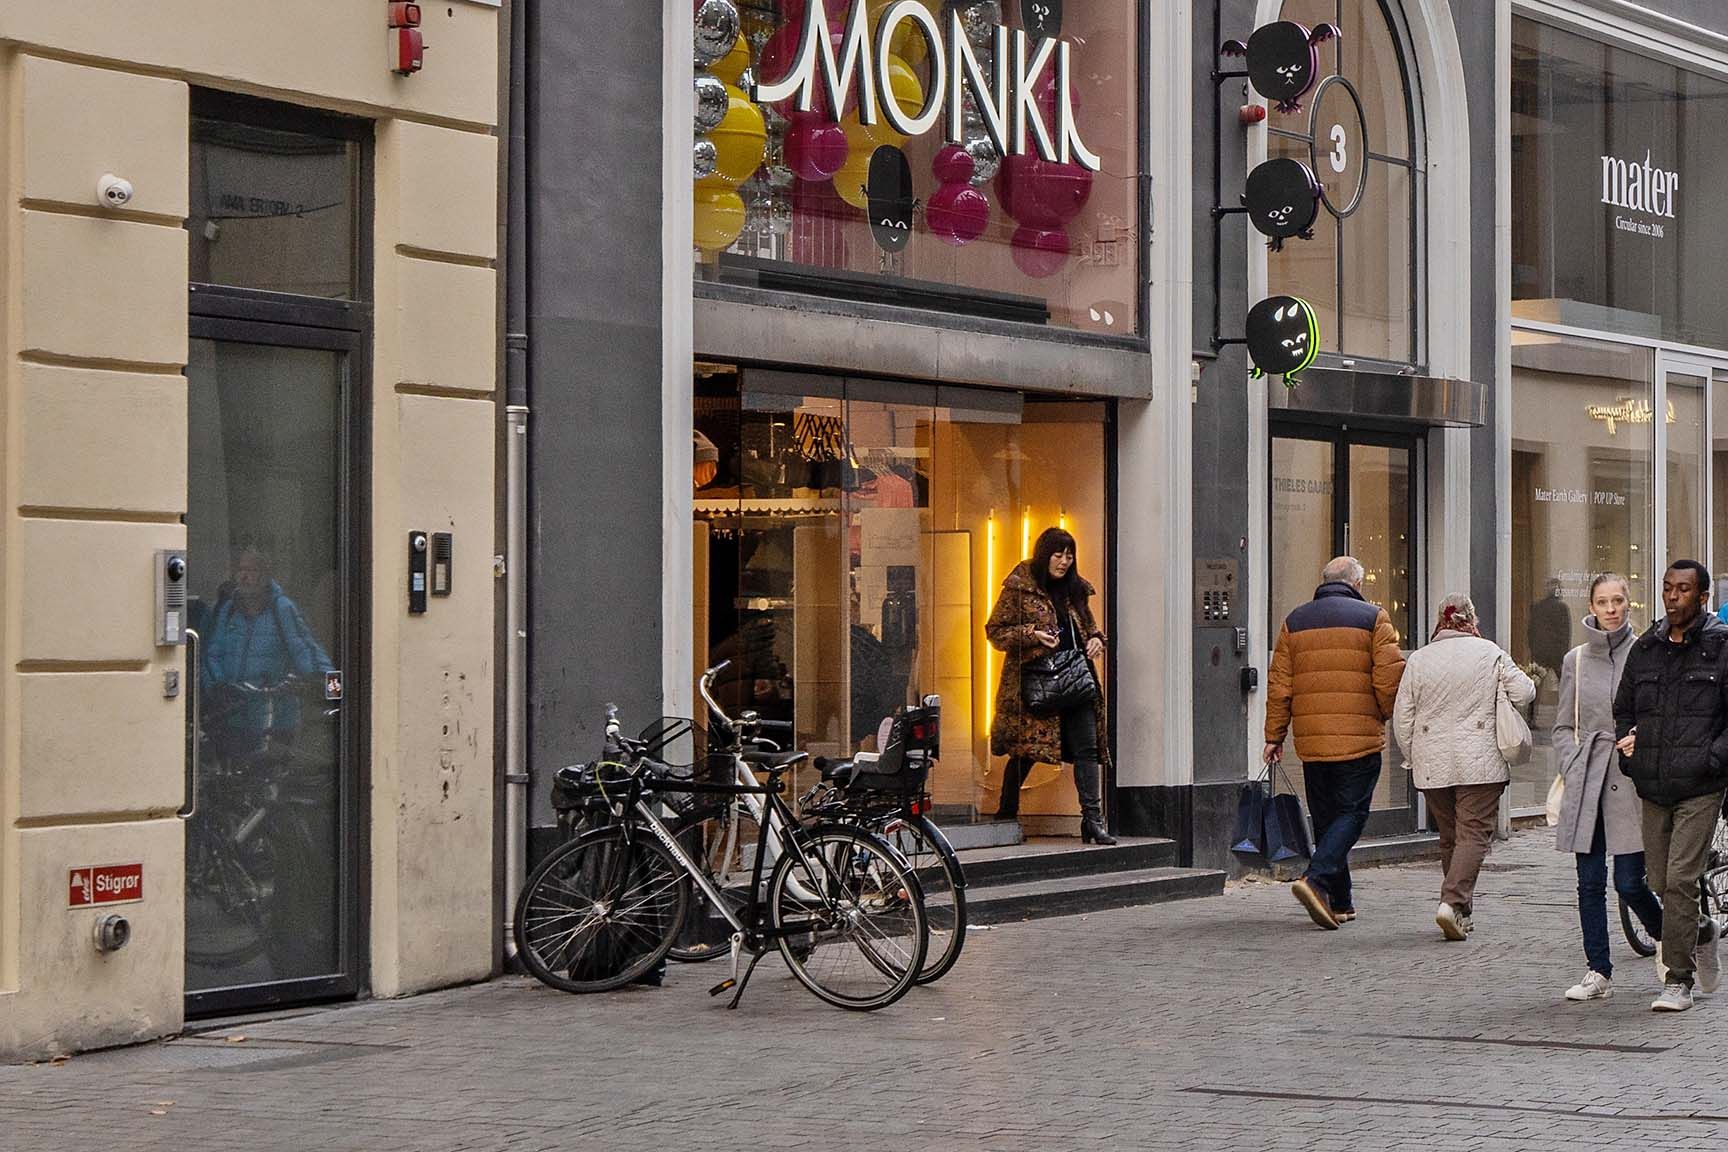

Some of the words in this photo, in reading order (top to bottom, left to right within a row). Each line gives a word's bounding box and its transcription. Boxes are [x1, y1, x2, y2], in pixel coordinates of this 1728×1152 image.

[1330, 124, 1346, 173] 3
[1601, 149, 1679, 218] mater
[1616, 216, 1637, 232] Circular
[1638, 220, 1651, 235] since
[1652, 224, 1664, 238] 2006
[1535, 488, 1552, 501] Mater
[1552, 488, 1567, 502] Earth
[96, 874, 139, 894] Stigrør
